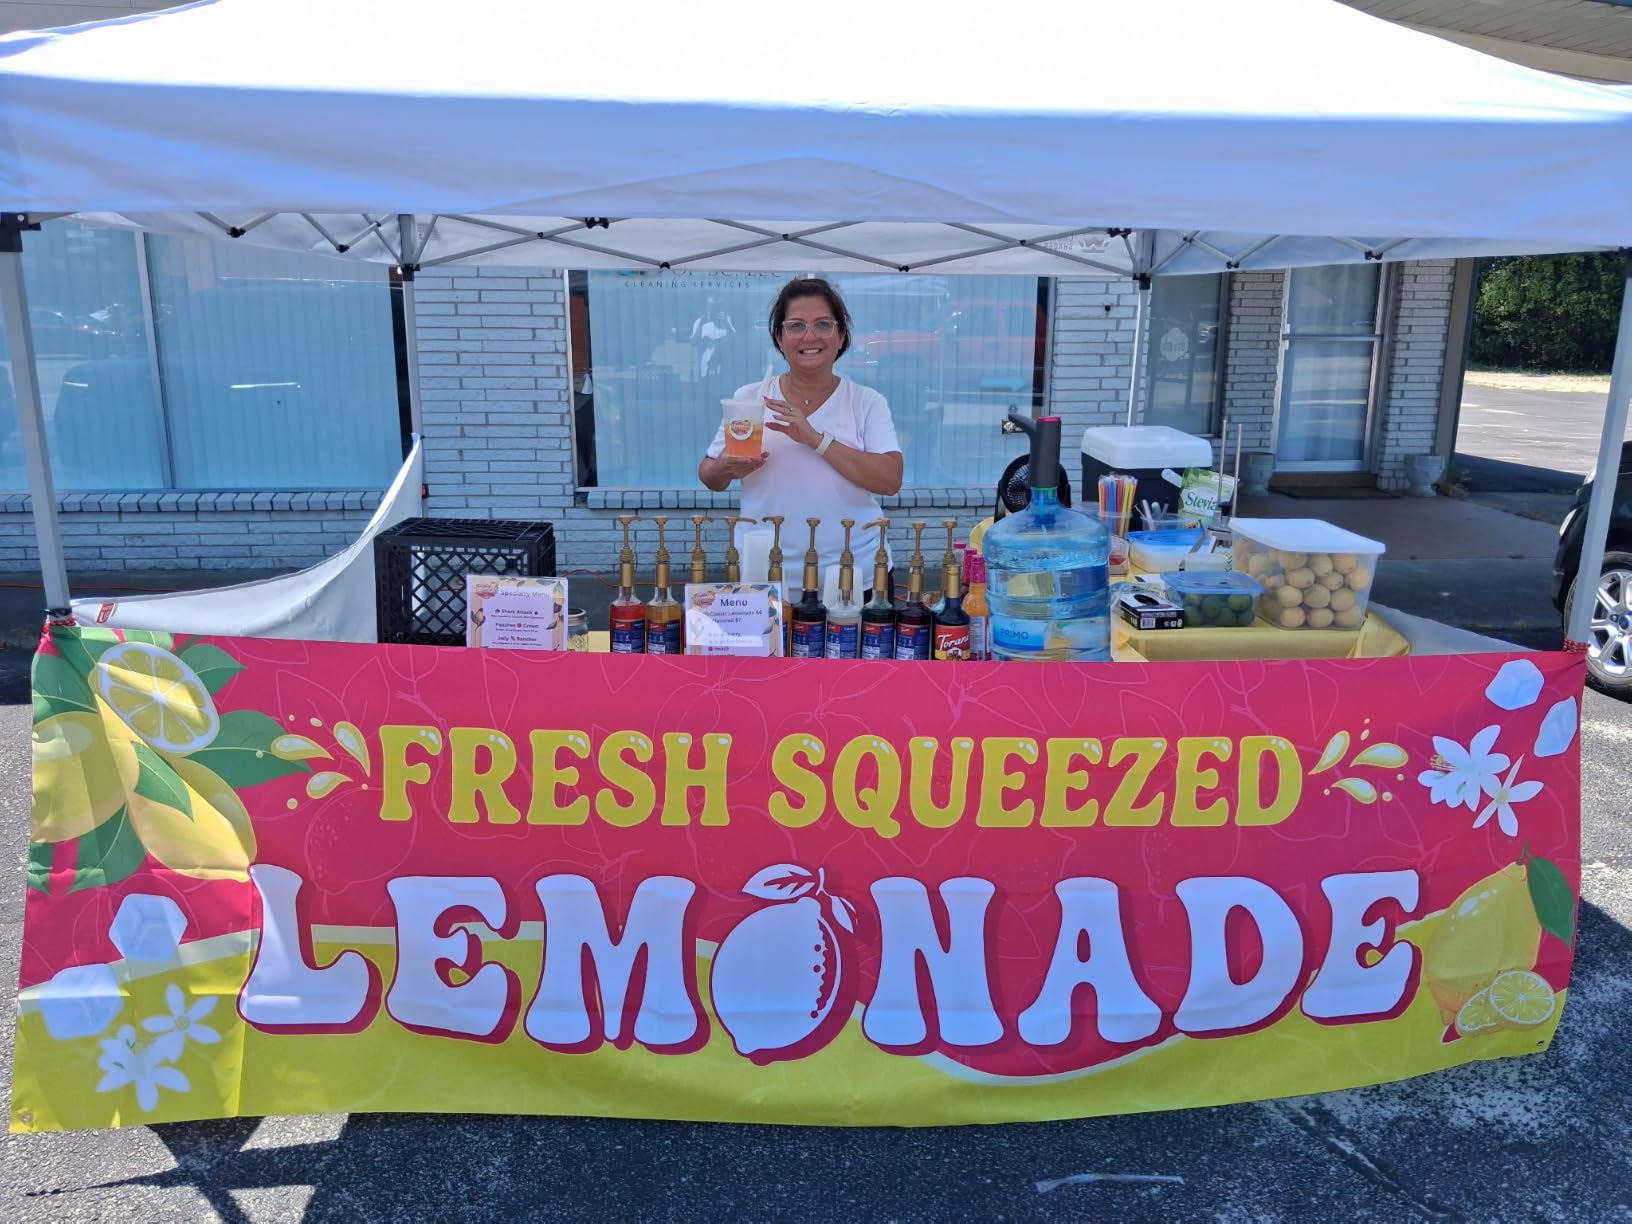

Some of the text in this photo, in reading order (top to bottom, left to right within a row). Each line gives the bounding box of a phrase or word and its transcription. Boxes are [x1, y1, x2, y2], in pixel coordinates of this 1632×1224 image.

[624, 280, 752, 288] CLEANING SERVICES
[1185, 492, 1218, 511] Stevia
[720, 598, 748, 607] Menu
[938, 631, 970, 651] Torani
[1001, 627, 1029, 640] PRIMO
[379, 725, 1304, 838] FRESH SQUEEZED
[238, 864, 1421, 1060] LEMONADE
